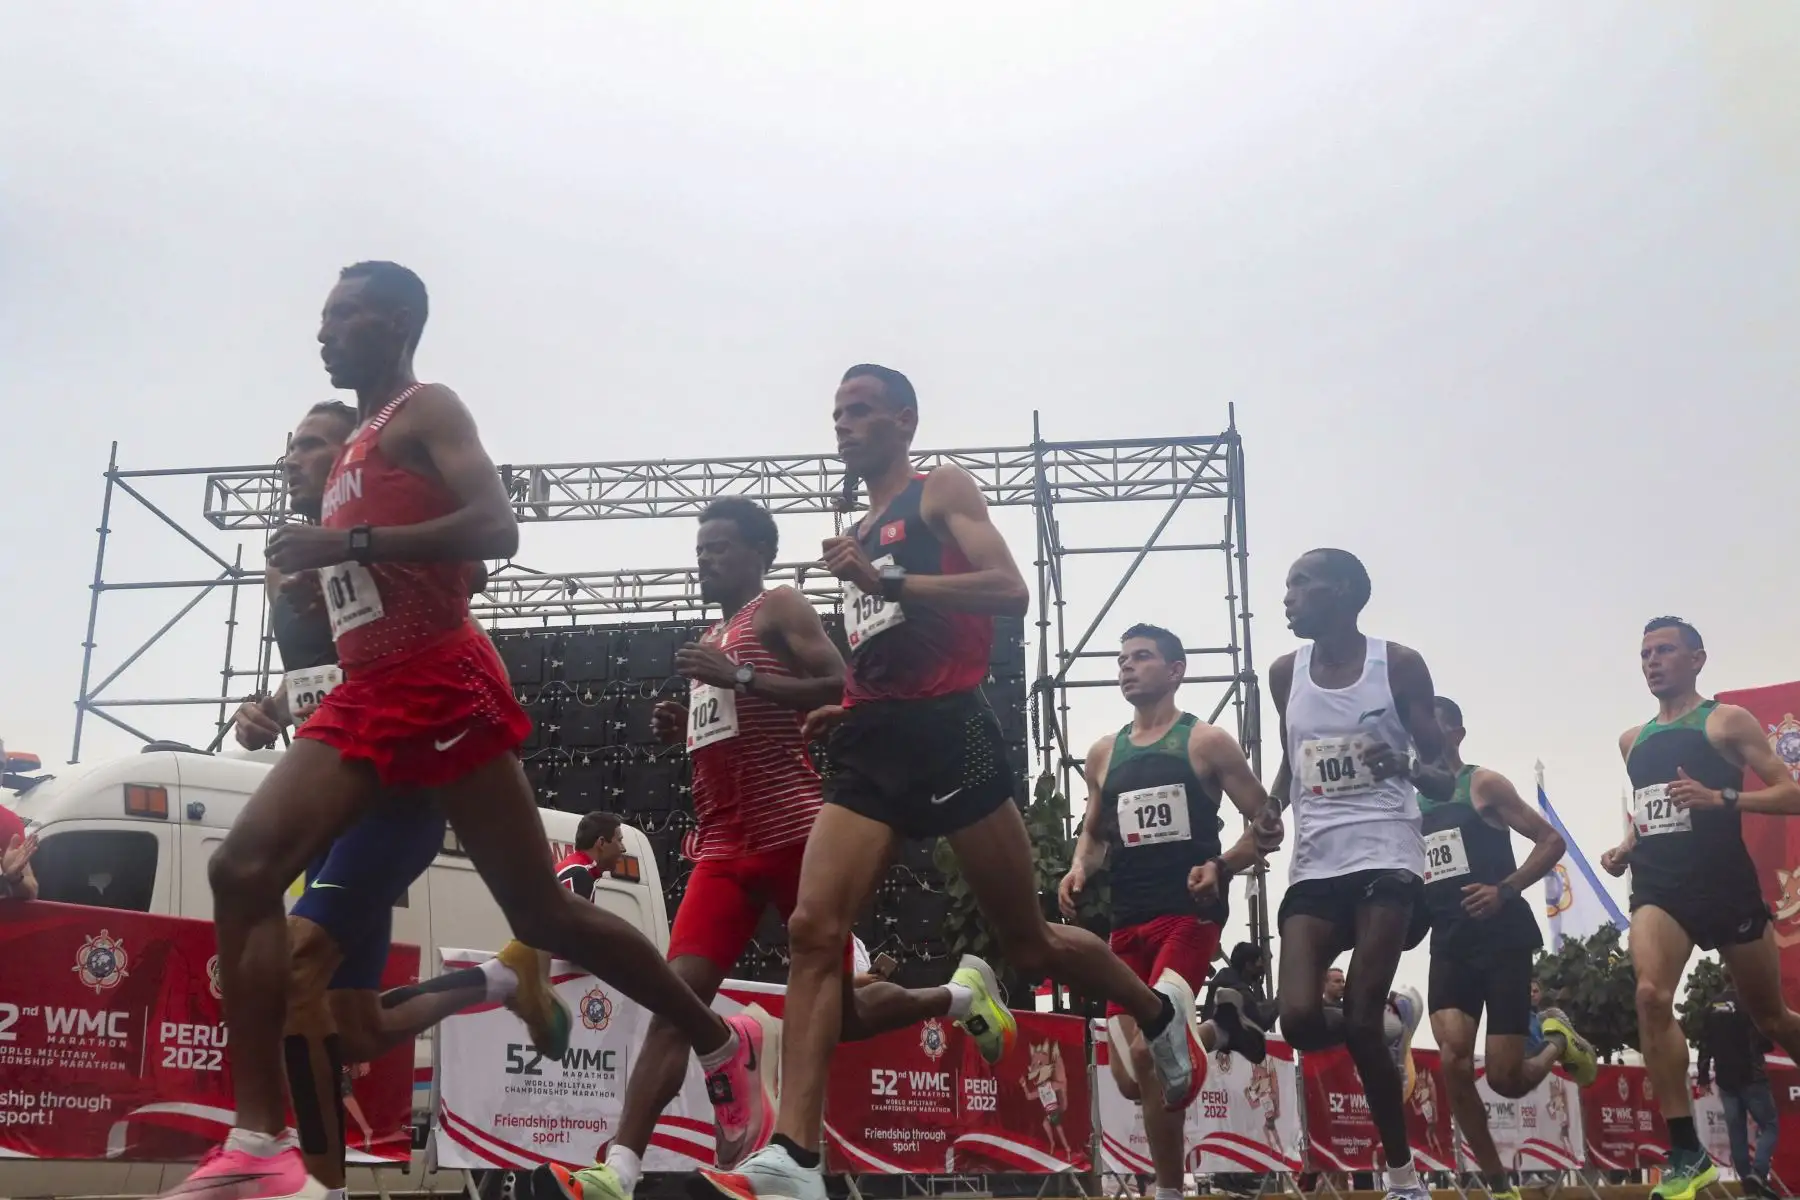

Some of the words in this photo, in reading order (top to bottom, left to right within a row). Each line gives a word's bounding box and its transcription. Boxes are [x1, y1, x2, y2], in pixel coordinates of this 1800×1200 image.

[692, 697, 720, 731] 102
[1316, 756, 1356, 783] 104
[1134, 803, 1173, 829] 129
[1644, 798, 1673, 821] 127
[1426, 844, 1453, 868] 128
[44, 1007, 129, 1038] WMC
[46, 1036, 127, 1047] MARATHON
[160, 1021, 228, 1047] PERÚ
[38, 1048, 96, 1060] MILITARY
[161, 1047, 223, 1071] 2022
[560, 1048, 616, 1071] WMC
[59, 1058, 126, 1070] MARATHON
[524, 1079, 553, 1088] WORLD
[557, 1080, 597, 1090] MILITARY
[562, 1070, 615, 1080] MARATHON
[909, 1071, 950, 1091] WMC
[504, 1086, 569, 1096] CHAMPIONSHIP
[572, 1087, 615, 1098] MARATHON
[964, 1077, 997, 1095] PERÚ
[40, 1092, 112, 1112] through
[966, 1096, 996, 1111] 2022
[1204, 1106, 1228, 1118] 2022
[494, 1114, 557, 1131] Friendship
[560, 1116, 608, 1132] through
[864, 1128, 910, 1141] Friendship
[912, 1129, 946, 1142] through
